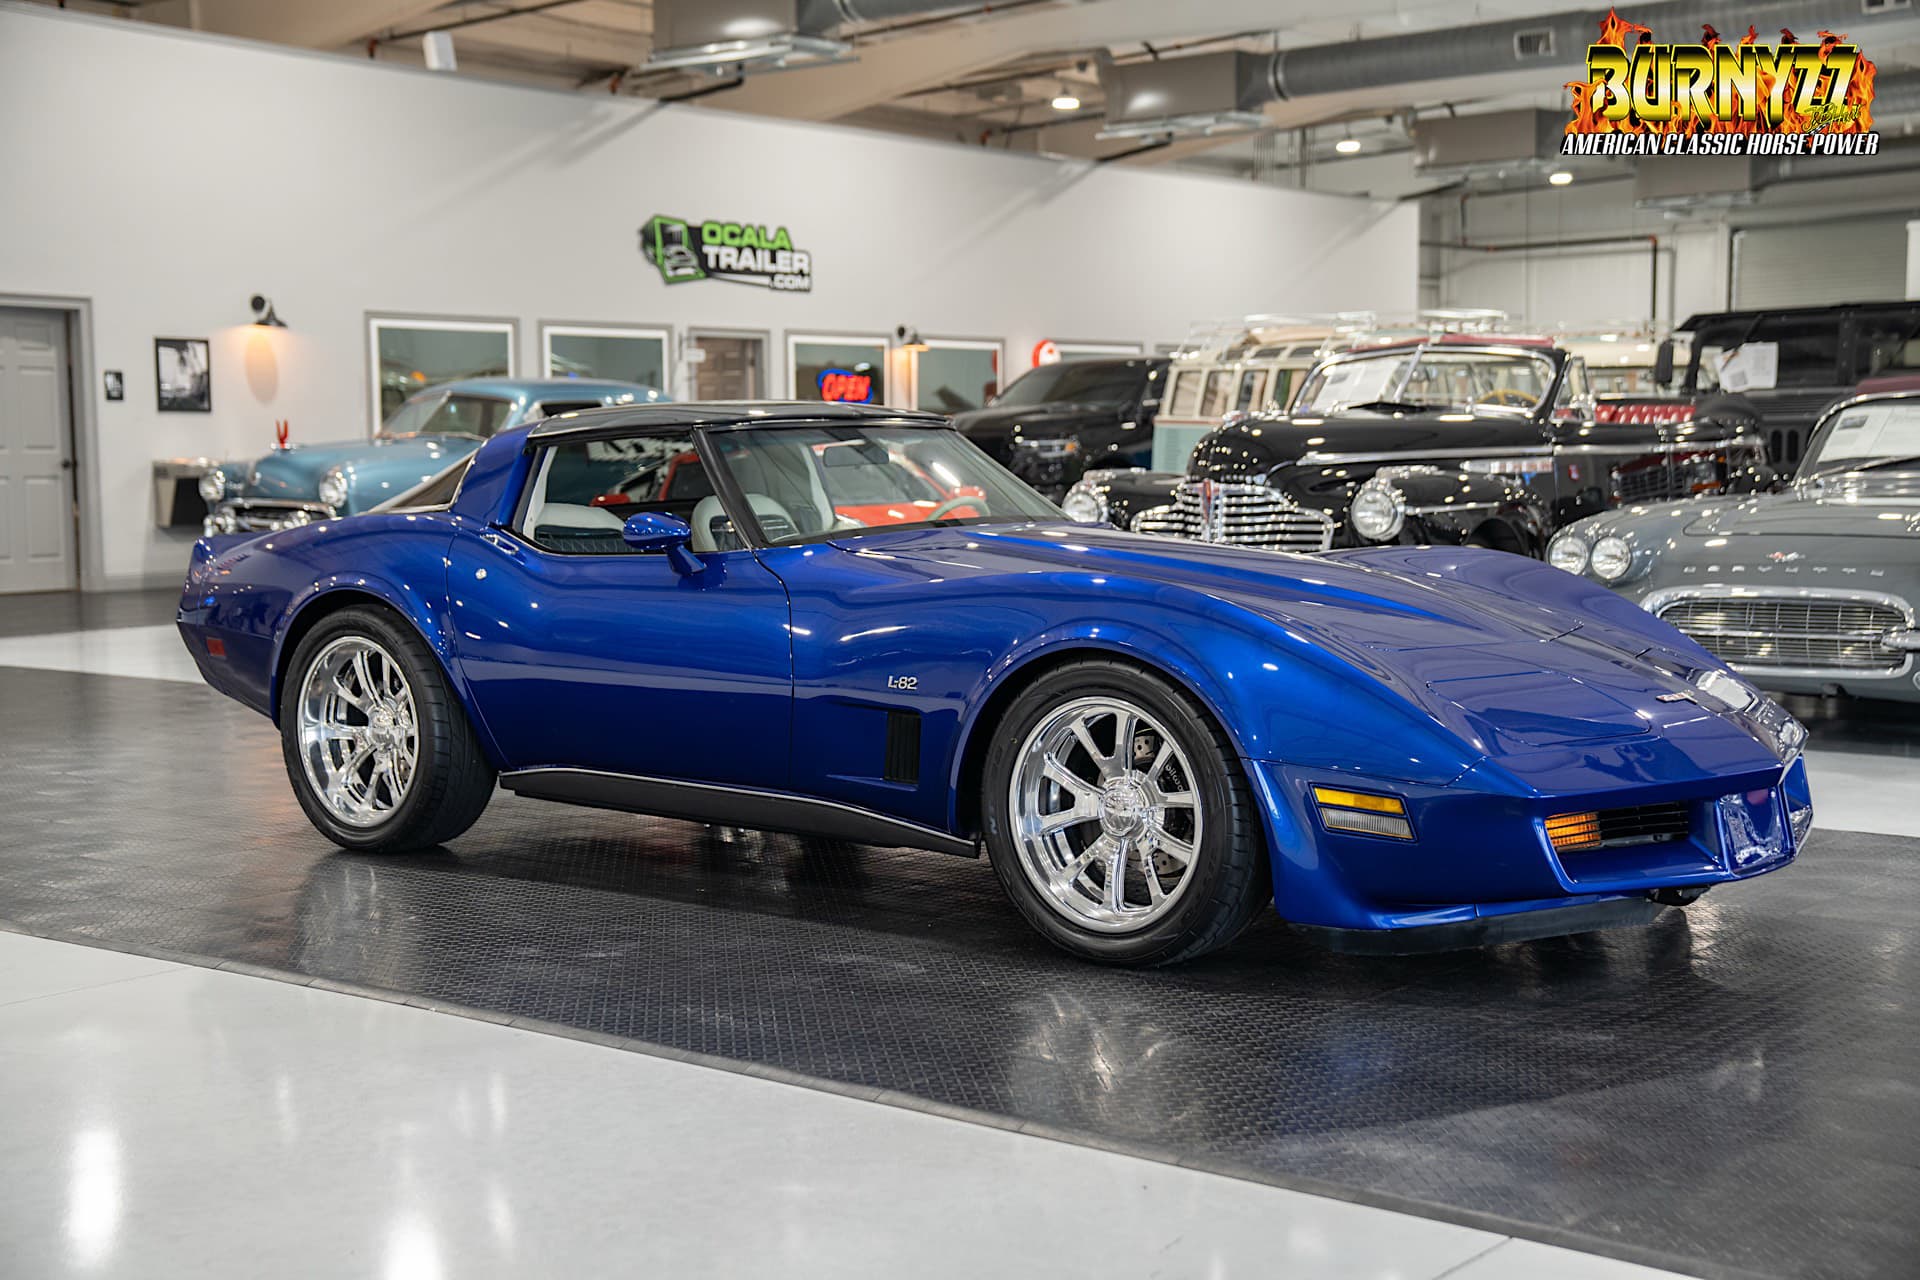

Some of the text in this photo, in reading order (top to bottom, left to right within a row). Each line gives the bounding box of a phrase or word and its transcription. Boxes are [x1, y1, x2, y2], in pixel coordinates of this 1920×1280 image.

[702, 221, 792, 249] OCALA
[702, 245, 811, 274] TRAILER
[770, 274, 811, 292] .COM
[822, 373, 871, 401] OPEN
[888, 675, 918, 690] L-82
